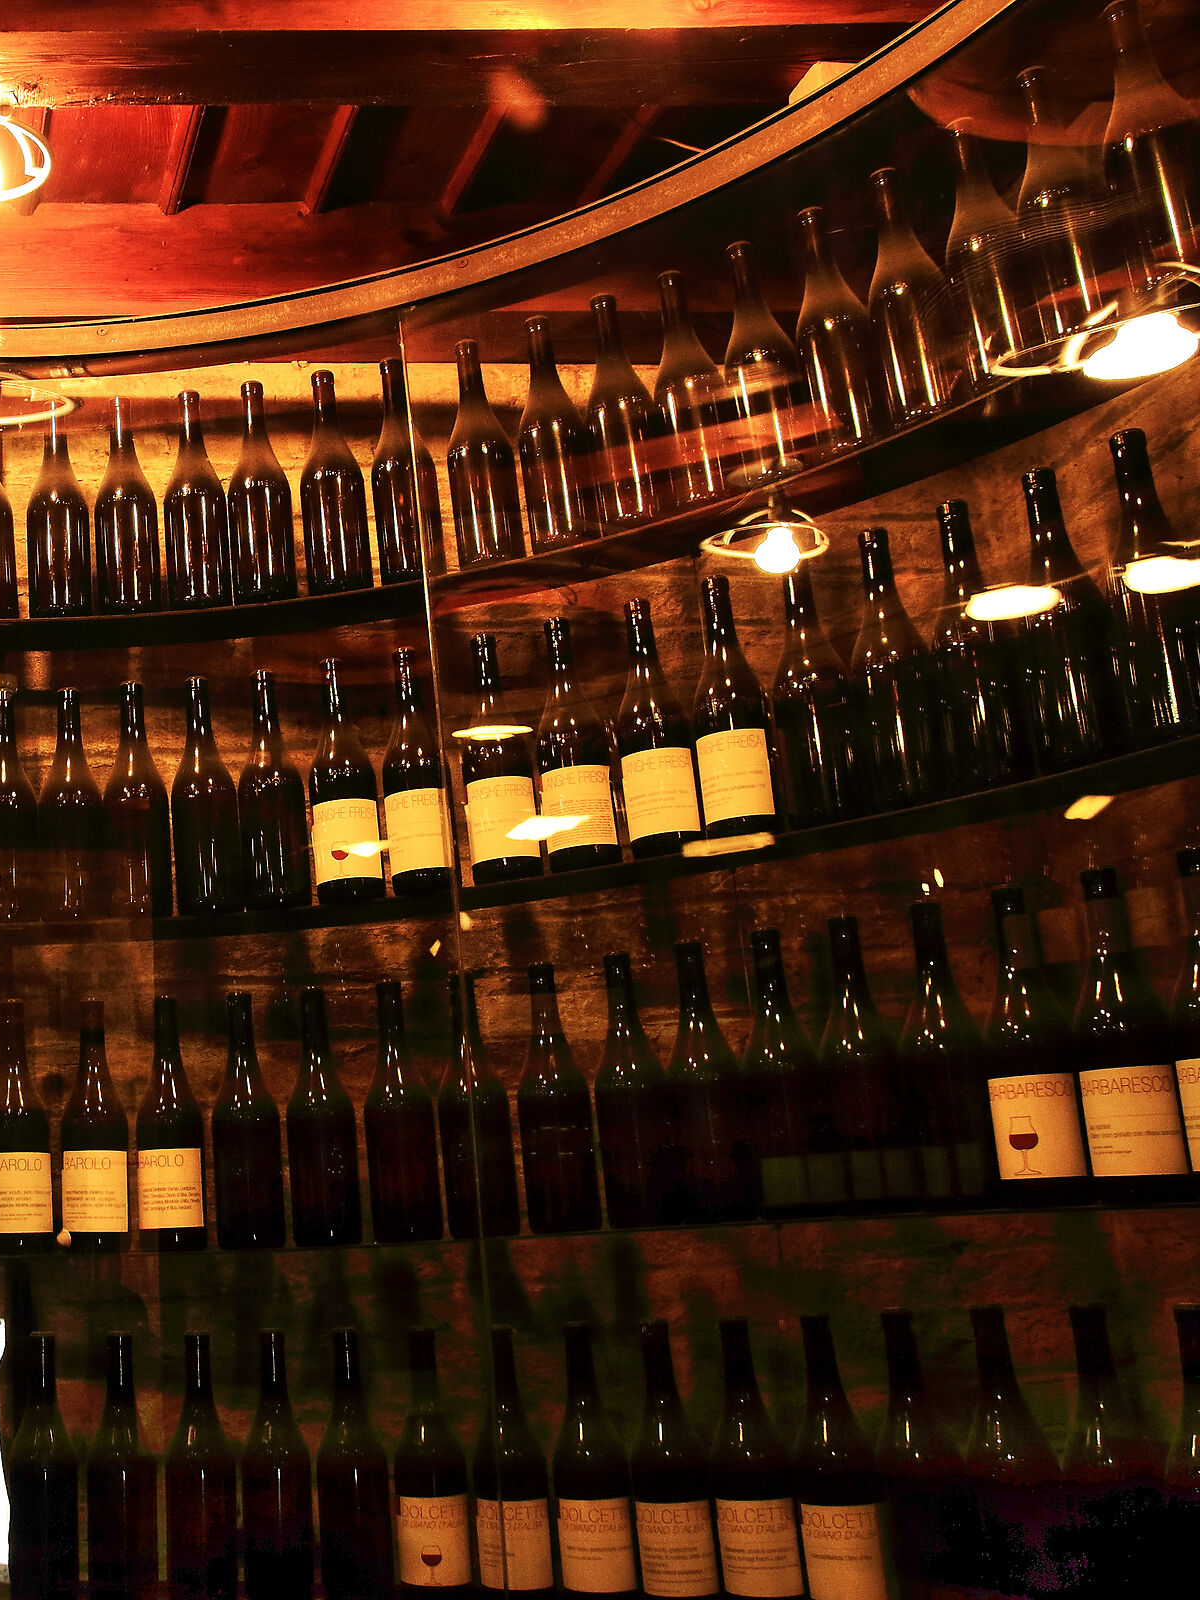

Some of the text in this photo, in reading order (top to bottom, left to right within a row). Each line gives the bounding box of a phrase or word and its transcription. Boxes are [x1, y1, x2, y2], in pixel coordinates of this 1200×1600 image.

[1081, 1075, 1172, 1098] BARBARESCO
[64, 1156, 112, 1171] BAROLO
[138, 1154, 184, 1169] BAROLO
